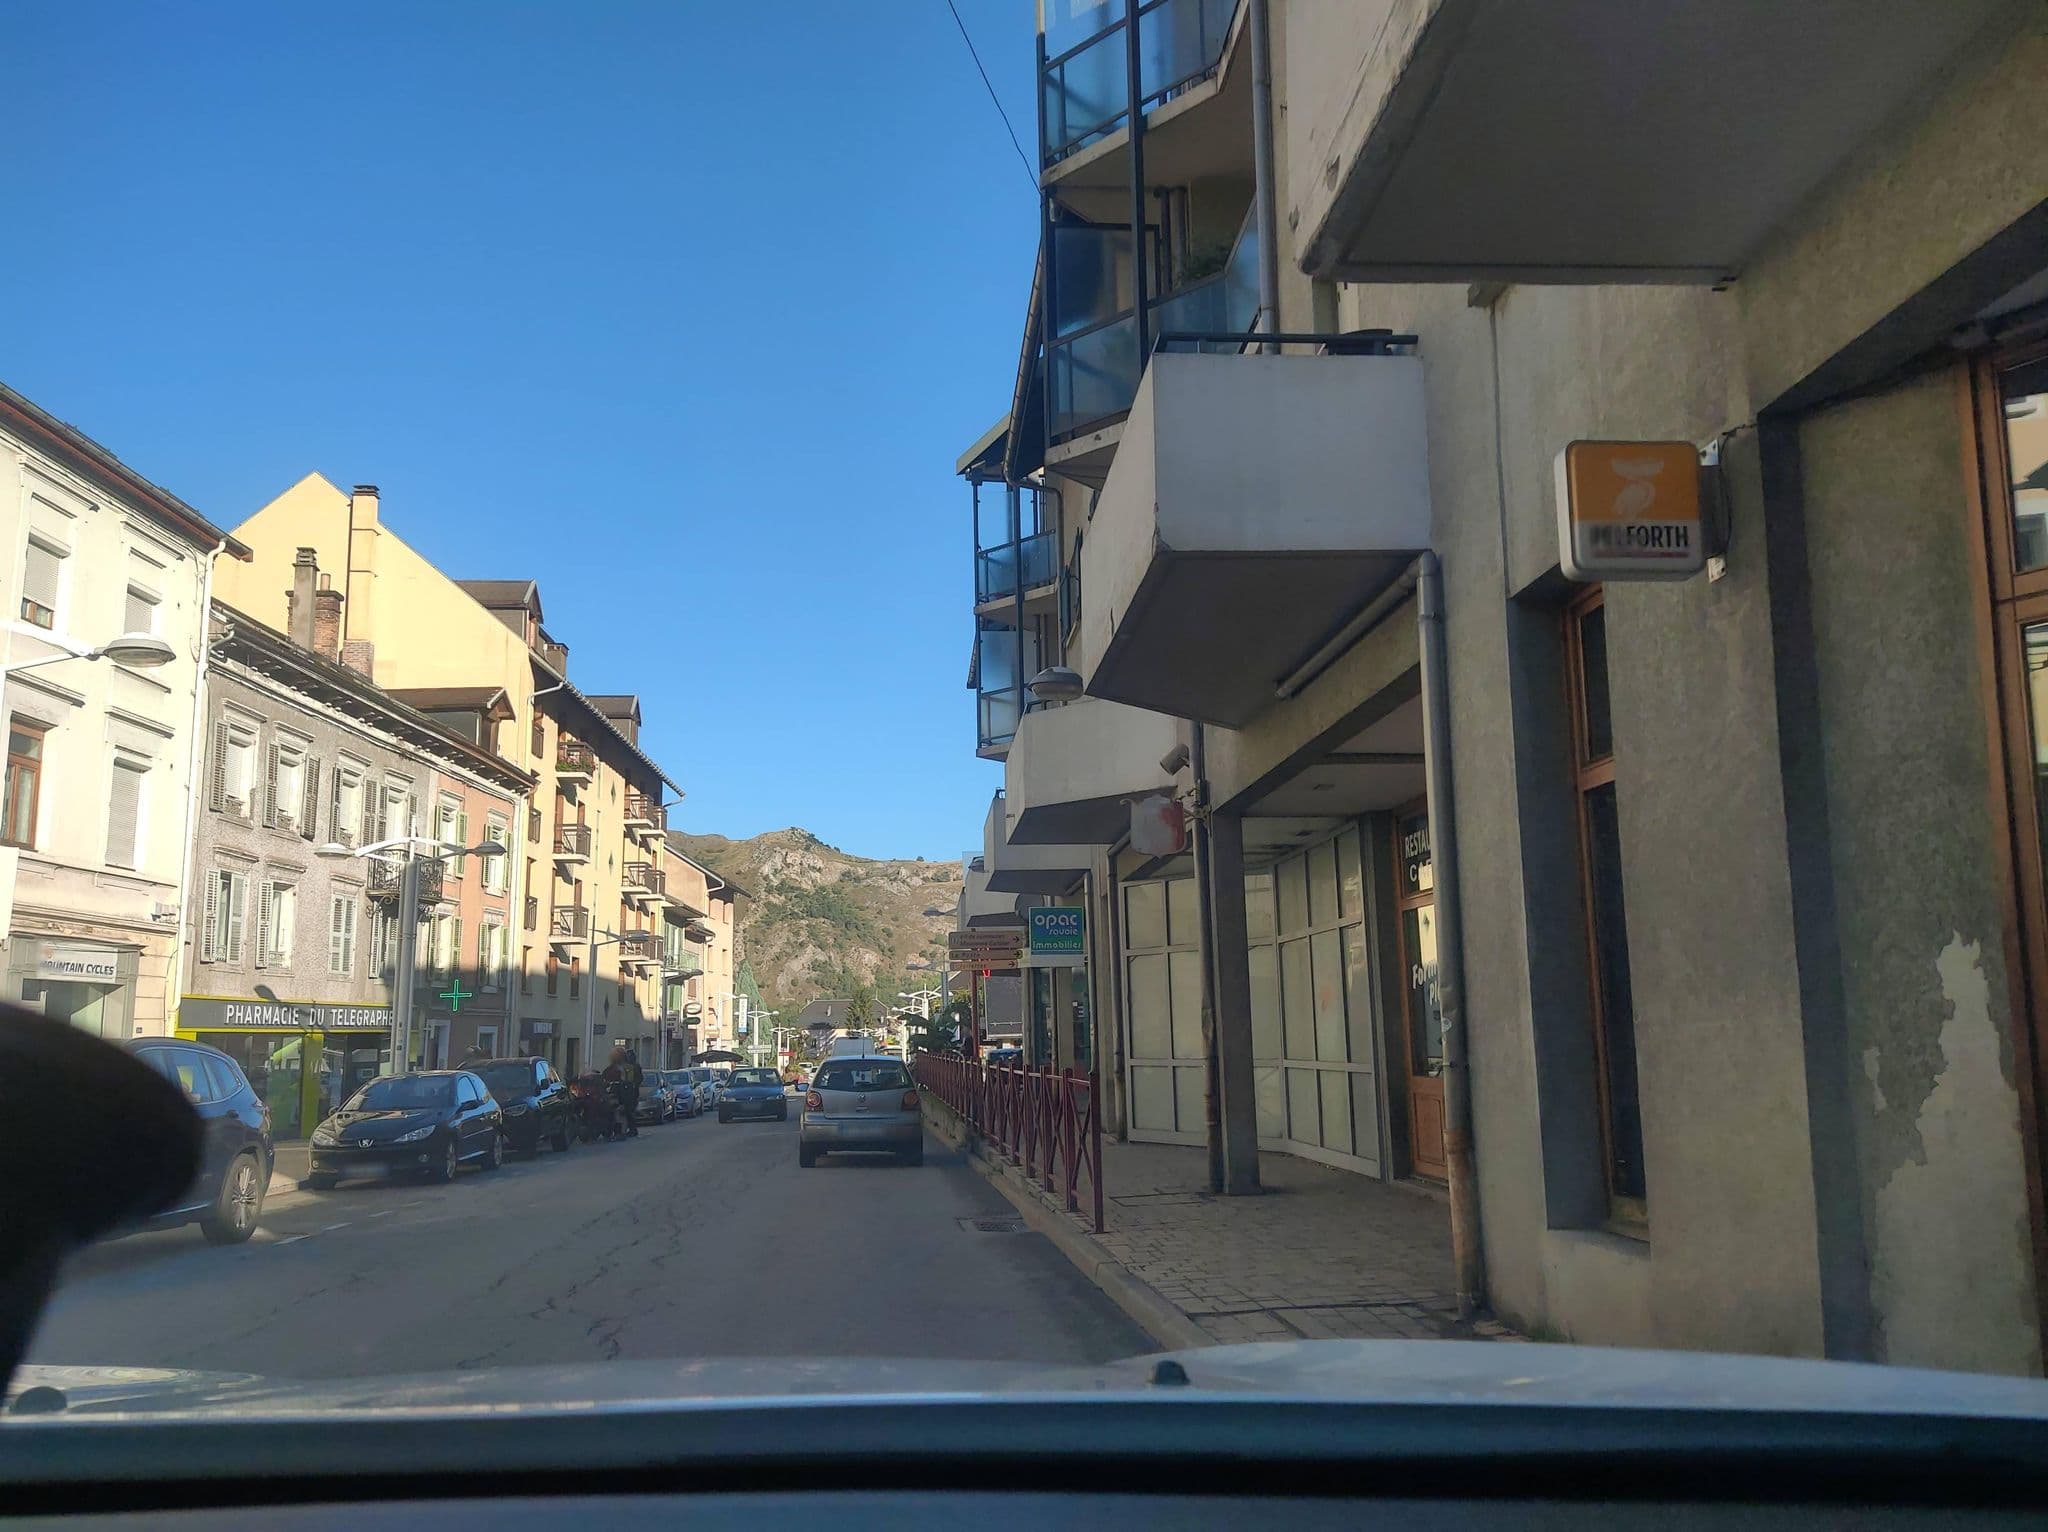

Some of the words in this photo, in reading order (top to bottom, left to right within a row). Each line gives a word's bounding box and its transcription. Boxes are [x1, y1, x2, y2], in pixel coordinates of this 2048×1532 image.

[1590, 525, 1689, 548] FORTH
[1035, 914, 1078, 930] opac
[1049, 926, 1079, 936] savoie
[86, 963, 115, 976] CYCLES
[225, 1004, 300, 1026] PHARMACIE
[309, 1007, 325, 1027] DU
